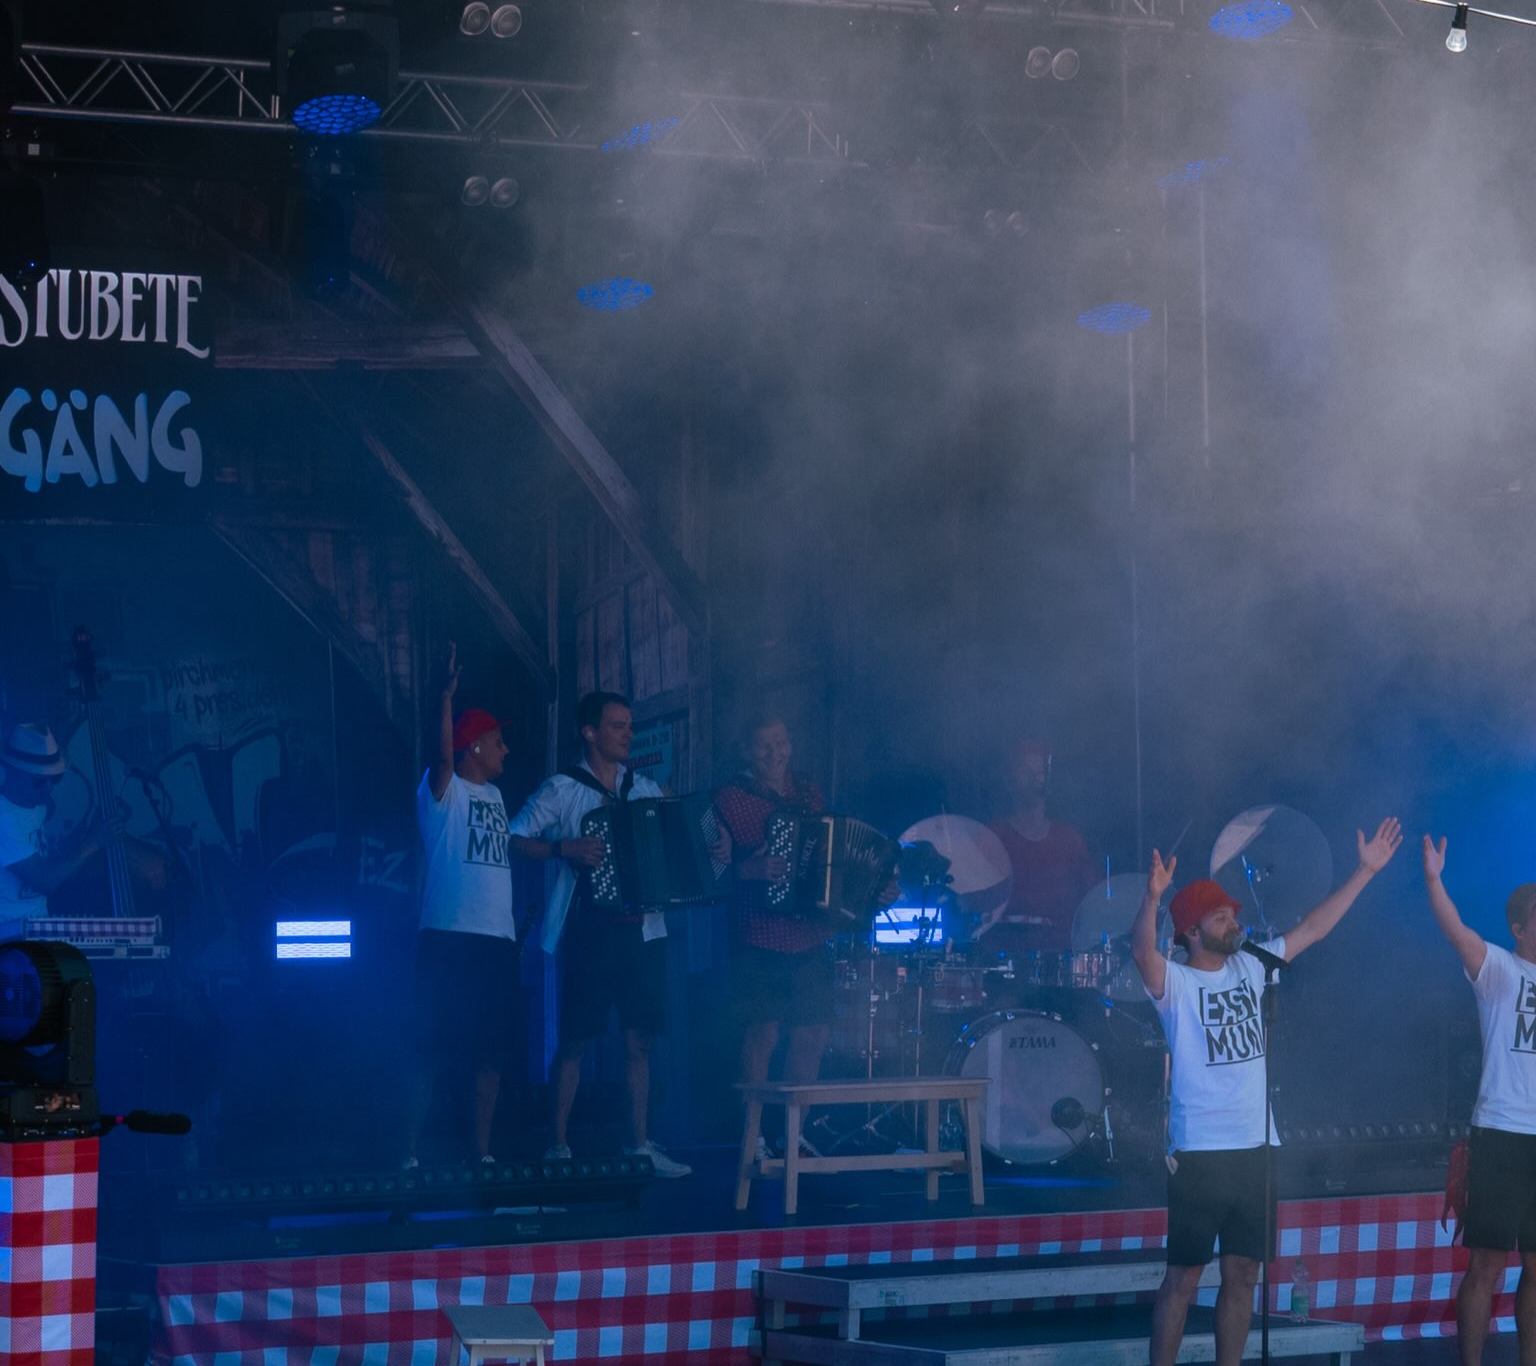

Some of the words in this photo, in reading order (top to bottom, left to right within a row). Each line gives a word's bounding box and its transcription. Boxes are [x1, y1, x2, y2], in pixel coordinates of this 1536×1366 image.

[0, 387, 203, 493] GÄNG
[1199, 978, 1258, 1026] EASY
[1016, 1035, 1056, 1049] TAMA
